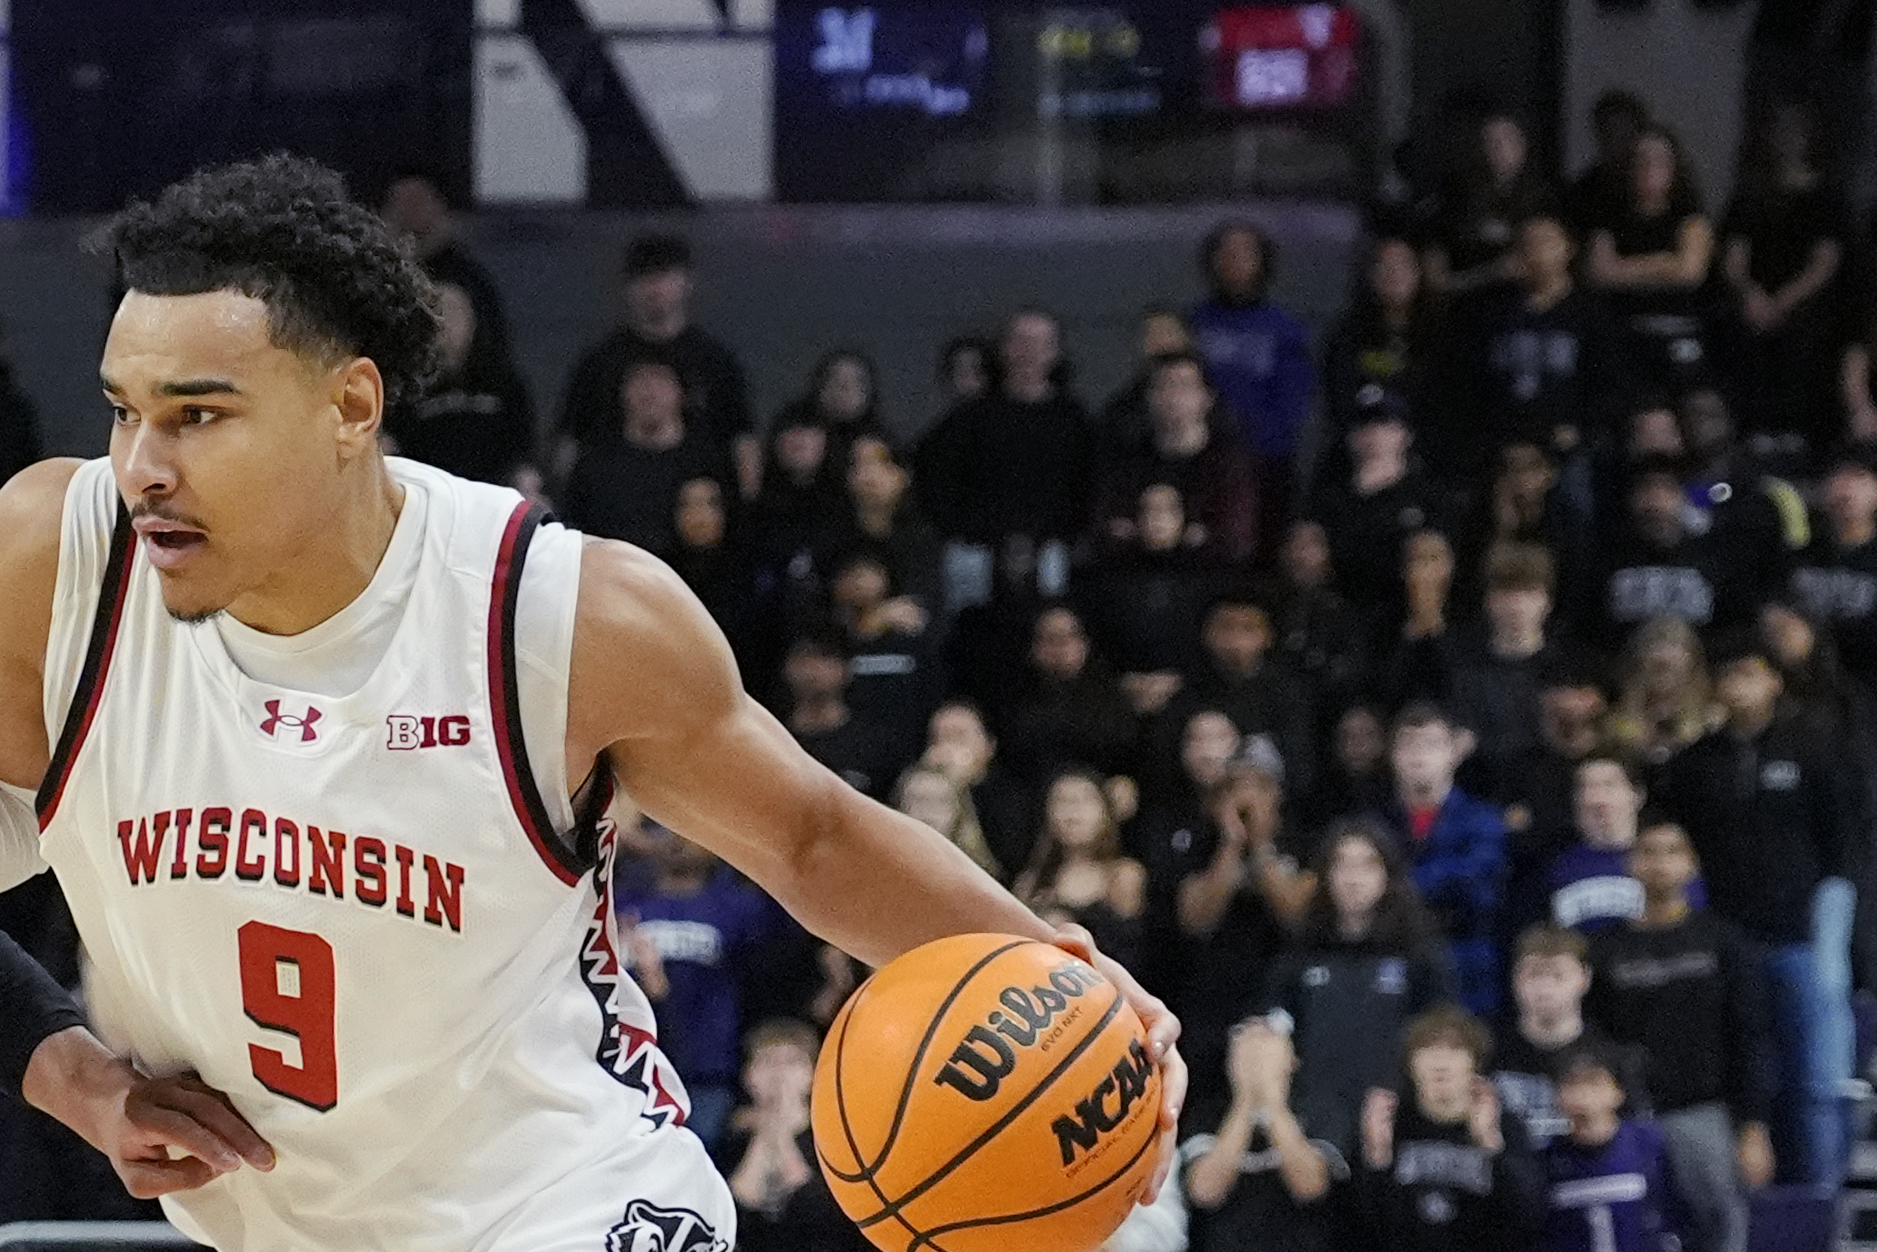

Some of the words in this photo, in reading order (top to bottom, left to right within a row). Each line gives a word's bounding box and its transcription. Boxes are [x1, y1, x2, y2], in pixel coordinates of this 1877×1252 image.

[386, 715, 471, 751] BIG
[118, 807, 465, 934] WISCONSIN
[237, 919, 339, 1115] 9
[933, 961, 1105, 1102] Wilson
[1051, 1037, 1154, 1168] NCAA
